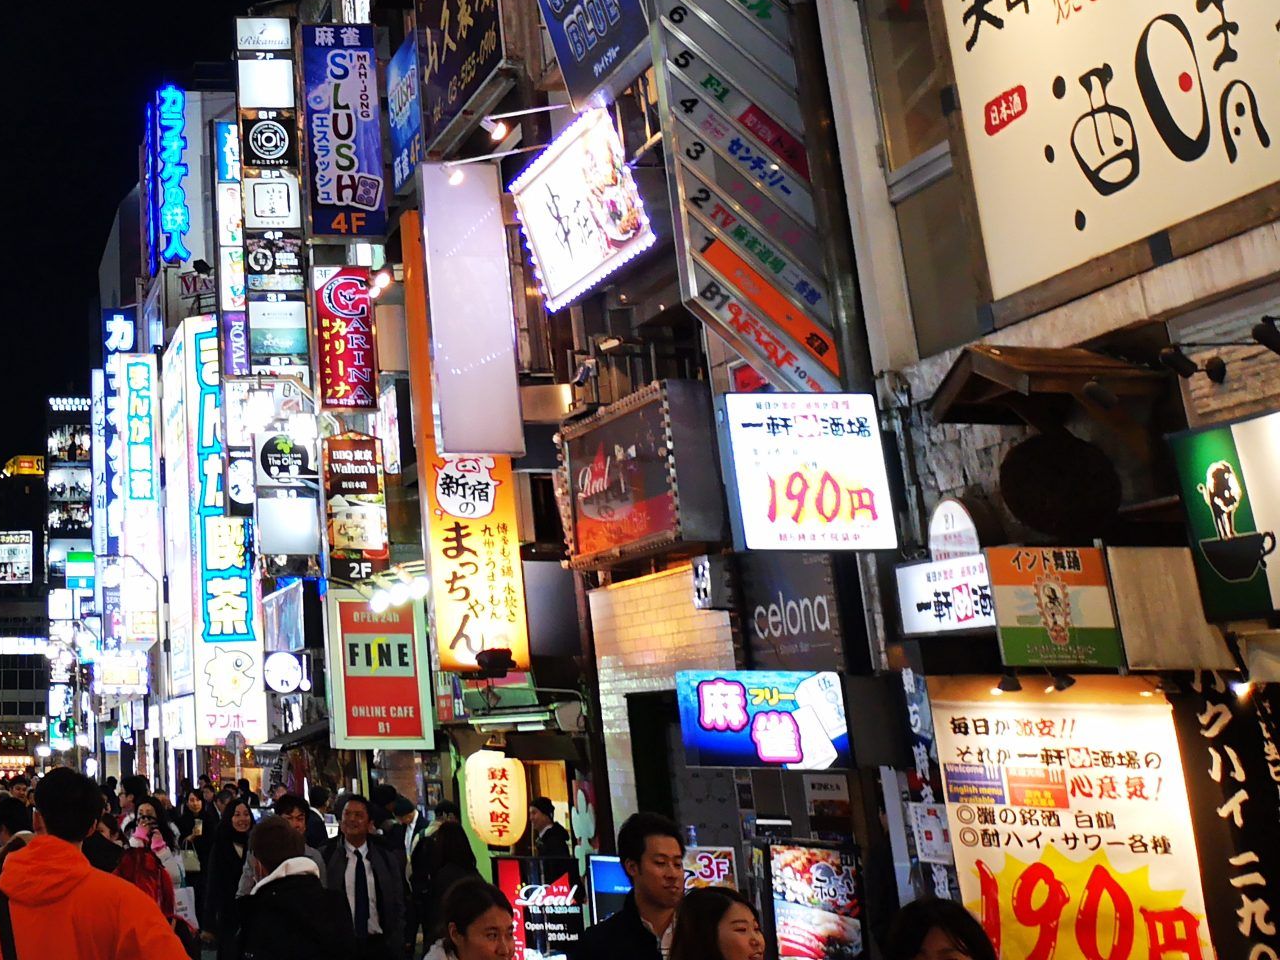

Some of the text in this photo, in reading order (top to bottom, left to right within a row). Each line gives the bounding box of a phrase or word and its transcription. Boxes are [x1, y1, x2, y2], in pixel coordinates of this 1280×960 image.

[669, 5, 688, 24] 6
[314, 26, 362, 47] 麻雀
[674, 49, 695, 69] 5
[679, 96, 699, 115] 4
[989, 95, 1022, 126] 日本酒
[314, 115, 333, 202] エスラッシュ
[685, 141, 706, 161] 3
[727, 137, 793, 196] センチュリー
[688, 188, 711, 209] 2
[709, 202, 737, 229] TV
[330, 212, 367, 234] 4F
[699, 281, 729, 311] B1
[331, 317, 352, 399] カリーナ
[331, 462, 376, 475] Walton's
[438, 472, 491, 502] 新宿
[766, 470, 880, 525] 190円
[459, 500, 476, 516] の
[349, 561, 372, 578] 2F
[1010, 548, 1084, 574] インド舞踊
[441, 521, 485, 654] まっちゃん
[753, 590, 833, 641] celona
[349, 642, 410, 668] FINE
[747, 687, 796, 706] フリー
[352, 705, 414, 719] ONLINE CAFE
[1069, 775, 1165, 802] 心意気!
[486, 766, 511, 838] 鉄なべ餃子
[695, 853, 730, 880] 3F
[515, 882, 580, 907] Real
[525, 922, 546, 932] Open
